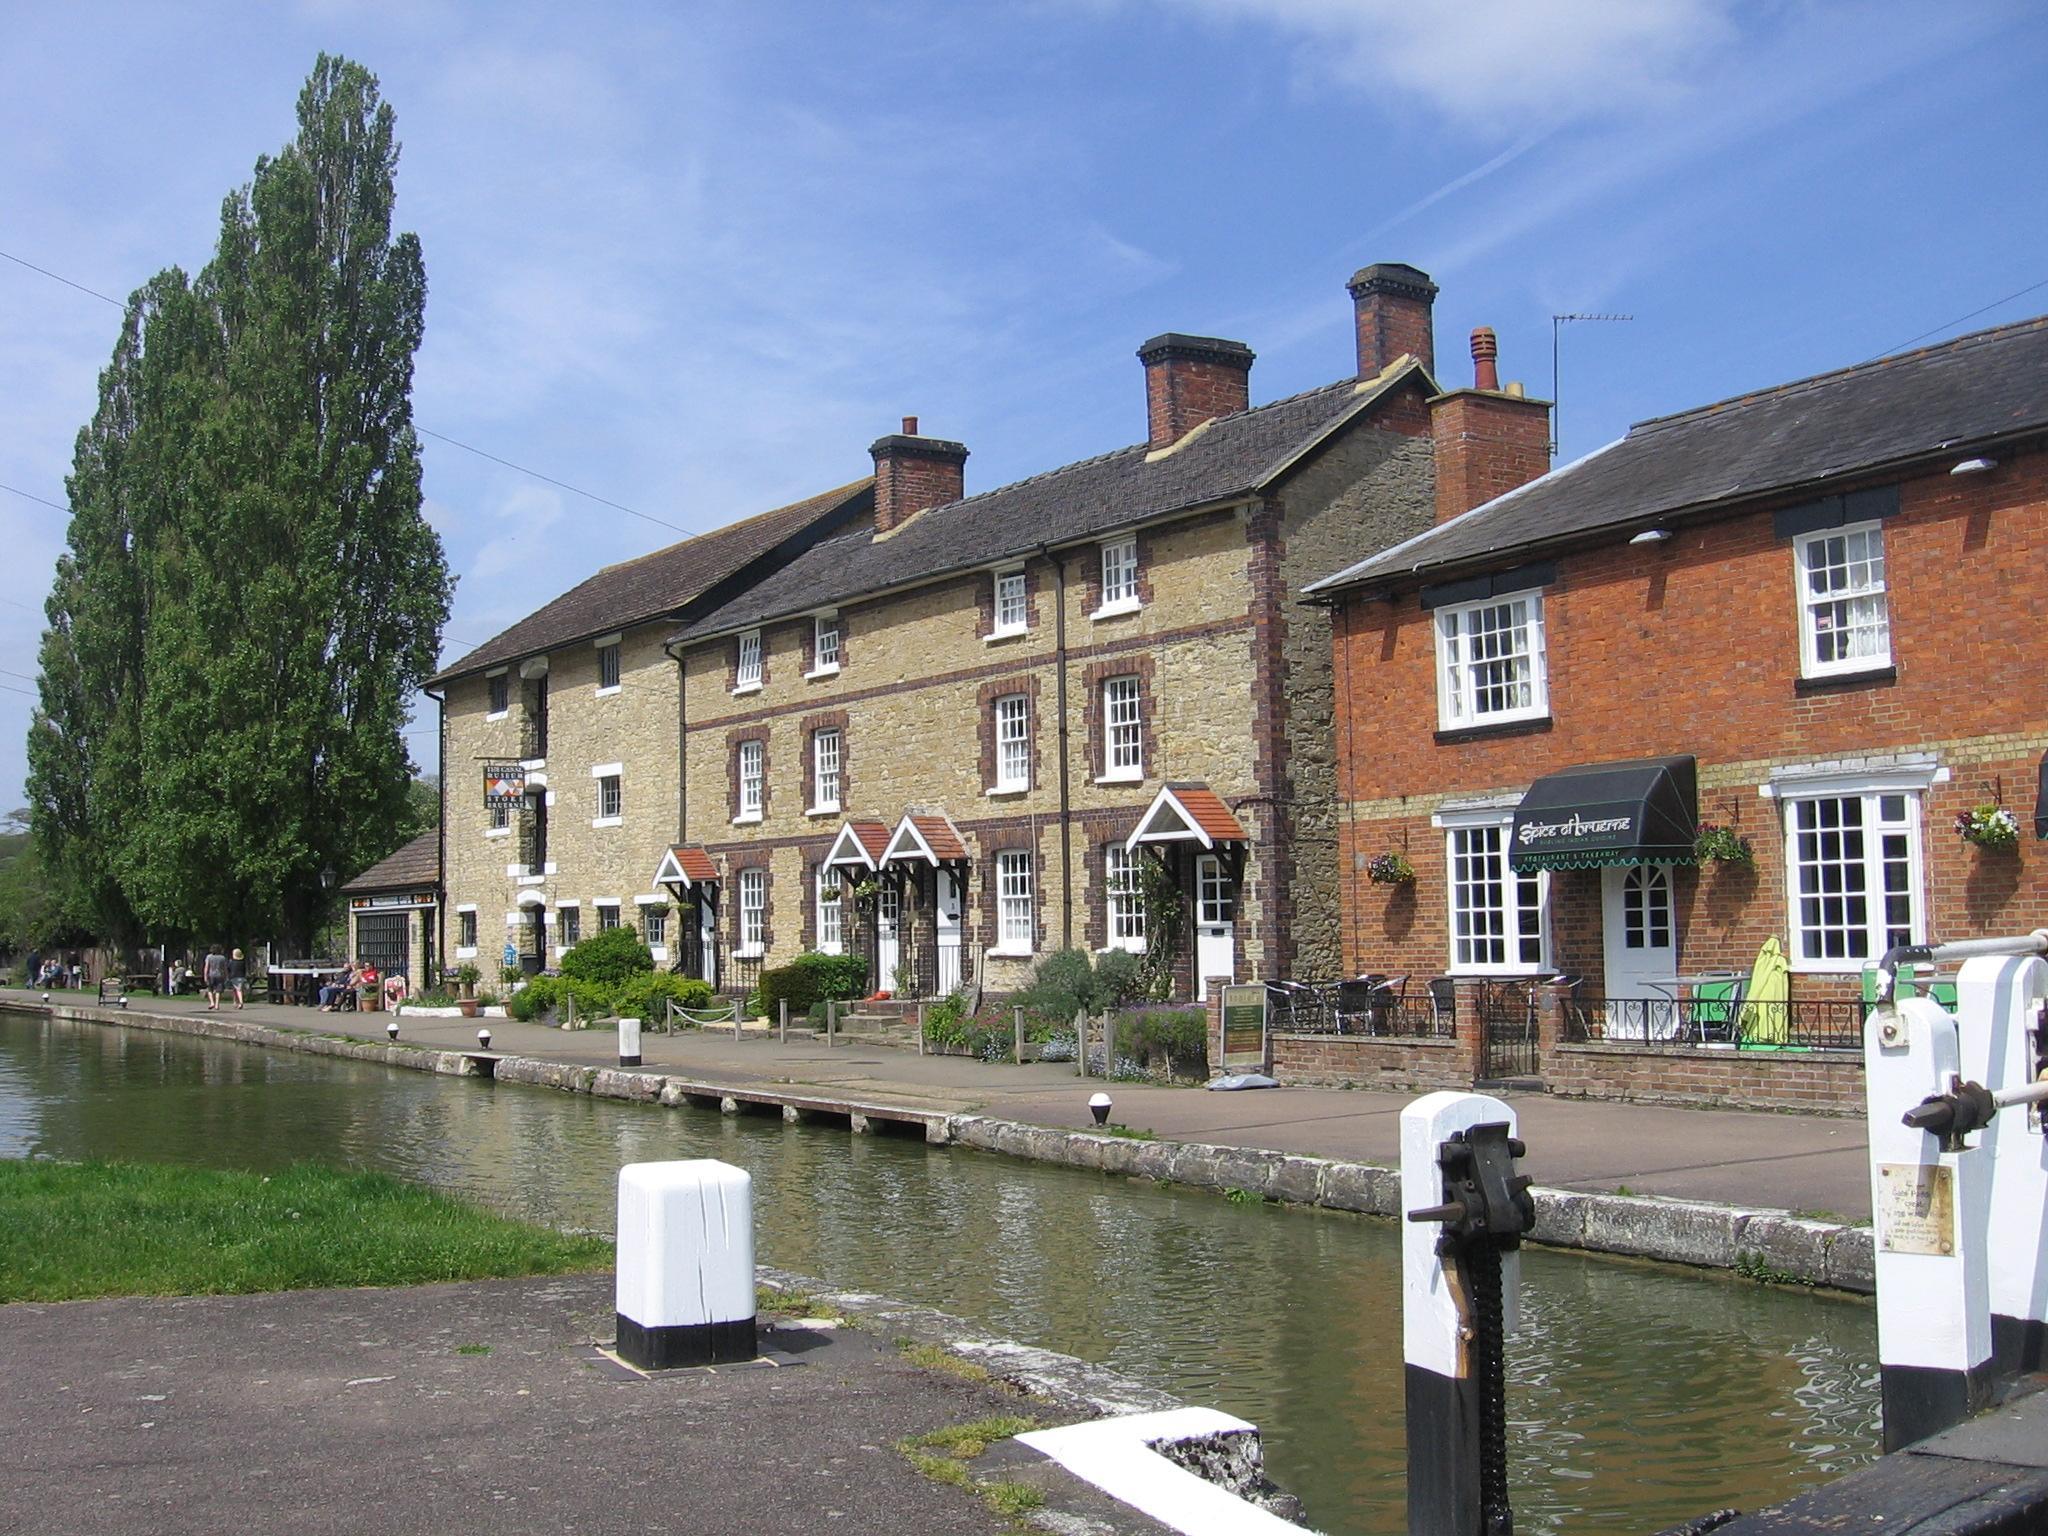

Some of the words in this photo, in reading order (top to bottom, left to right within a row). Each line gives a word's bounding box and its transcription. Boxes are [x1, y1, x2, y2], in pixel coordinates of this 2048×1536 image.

[1518, 821, 1556, 845] Spice
[1560, 818, 1575, 836] of
[1524, 853, 1570, 862] RESTAURANT
[1581, 851, 1620, 860] TAKEAWAY
